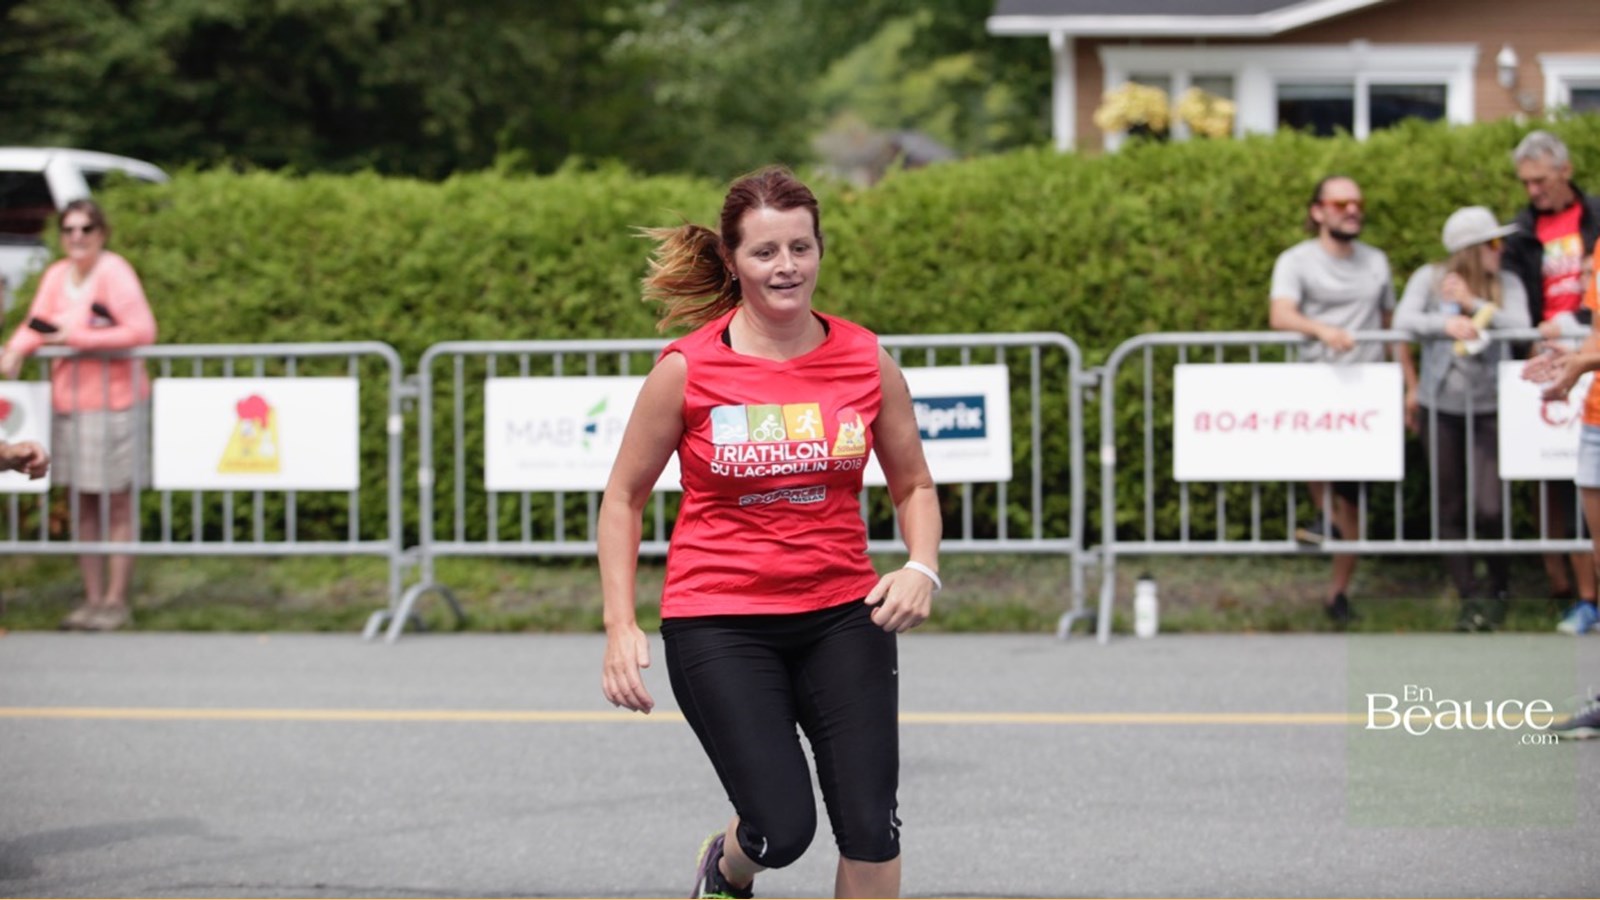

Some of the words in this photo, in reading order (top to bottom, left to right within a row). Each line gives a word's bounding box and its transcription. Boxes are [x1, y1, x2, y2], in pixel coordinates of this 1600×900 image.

[1193, 410, 1380, 434] BOA-FRANC
[713, 441, 828, 463] TRIATHLON
[711, 462, 730, 477] DU
[734, 461, 828, 478] LAC-POULIN
[833, 459, 862, 471] 2018
